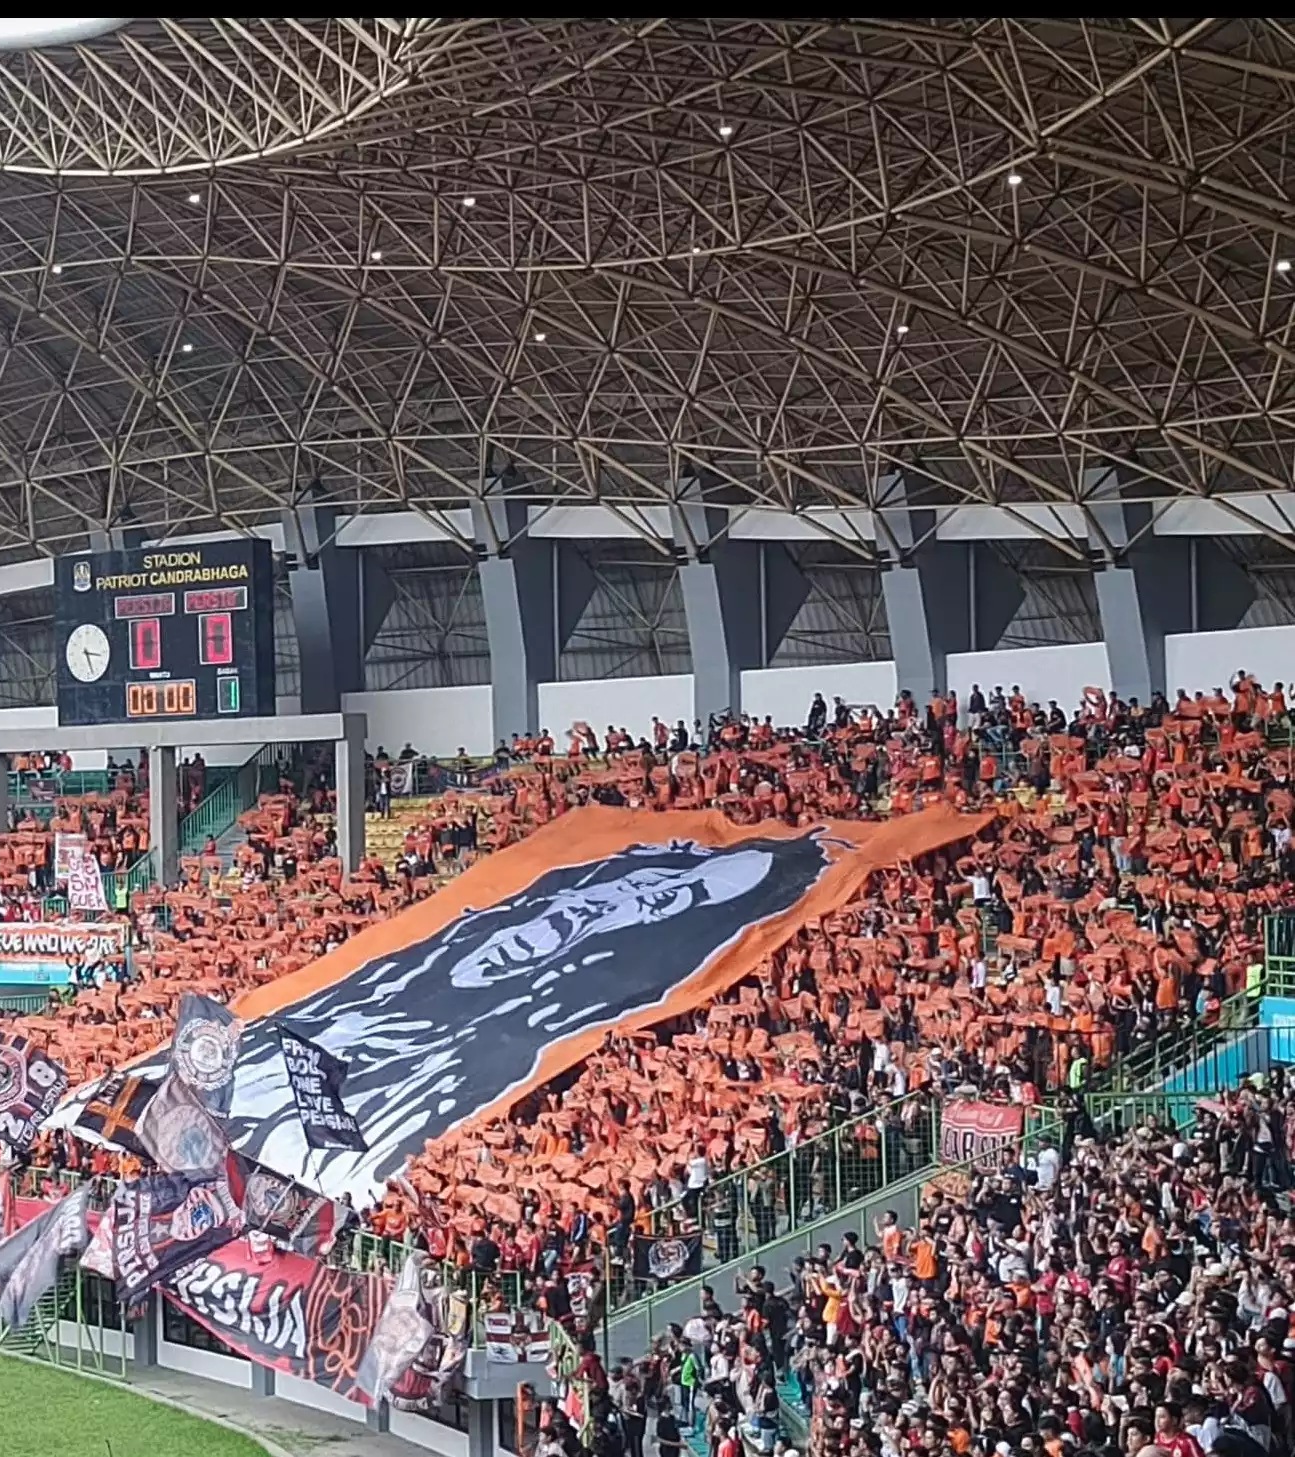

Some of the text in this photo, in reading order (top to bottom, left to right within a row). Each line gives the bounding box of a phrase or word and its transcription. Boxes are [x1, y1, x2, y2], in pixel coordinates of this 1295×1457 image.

[143, 551, 201, 570] STADION
[95, 565, 248, 590] PATRIOT CANDRABHAGA
[23, 934, 60, 955] WHO
[60, 935, 85, 954] WE
